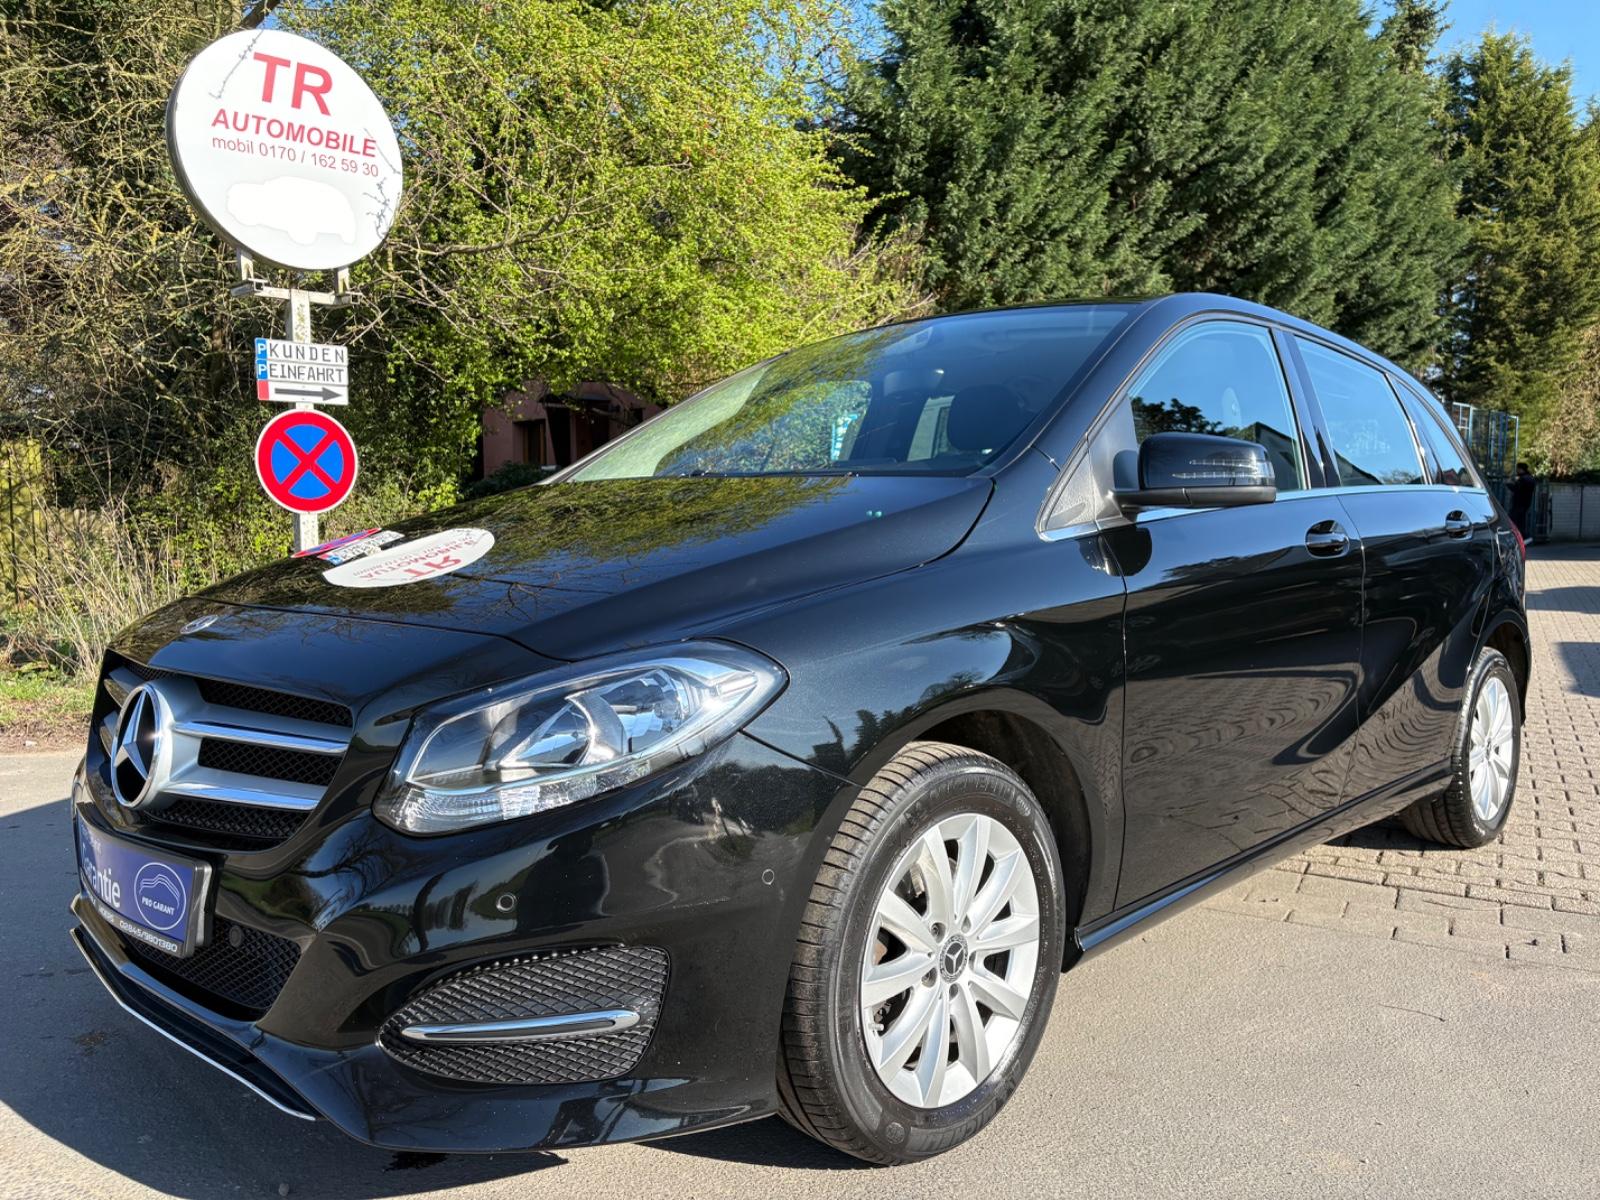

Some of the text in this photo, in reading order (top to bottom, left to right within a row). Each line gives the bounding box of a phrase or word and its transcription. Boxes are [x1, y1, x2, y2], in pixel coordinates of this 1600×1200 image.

[253, 52, 333, 116] TR
[211, 108, 376, 158] AUTOMOBILE
[212, 135, 254, 155] mobil
[259, 142, 296, 162] 0170
[311, 152, 337, 169] 162
[341, 157, 358, 174] 59
[362, 162, 379, 177] 30
[269, 342, 345, 364] KUNDEN
[269, 363, 345, 383] EINFAHRT
[142, 896, 175, 916] PRO GARANT
